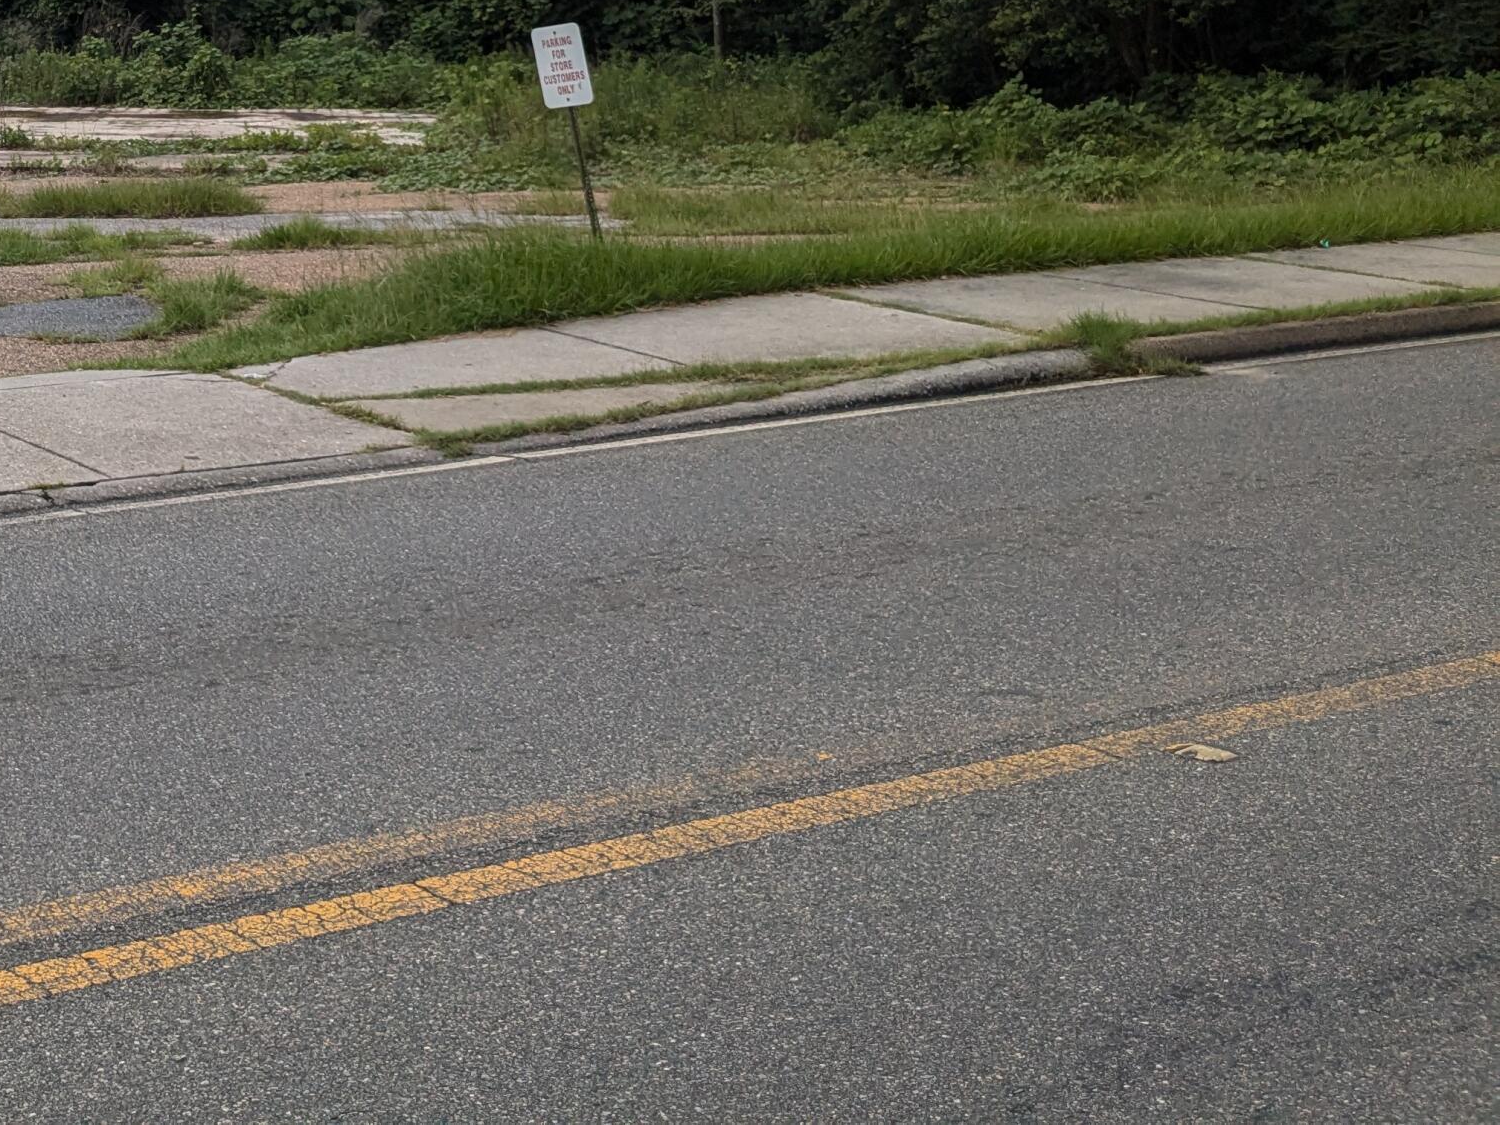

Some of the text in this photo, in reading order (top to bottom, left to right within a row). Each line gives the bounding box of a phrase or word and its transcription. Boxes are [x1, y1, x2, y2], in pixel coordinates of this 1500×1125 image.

[541, 35, 573, 49] PARKING
[551, 49, 566, 59] FOR
[550, 60, 573, 72] STORE
[543, 70, 585, 85] CUSTOMERS
[557, 84, 574, 95] ONLY
